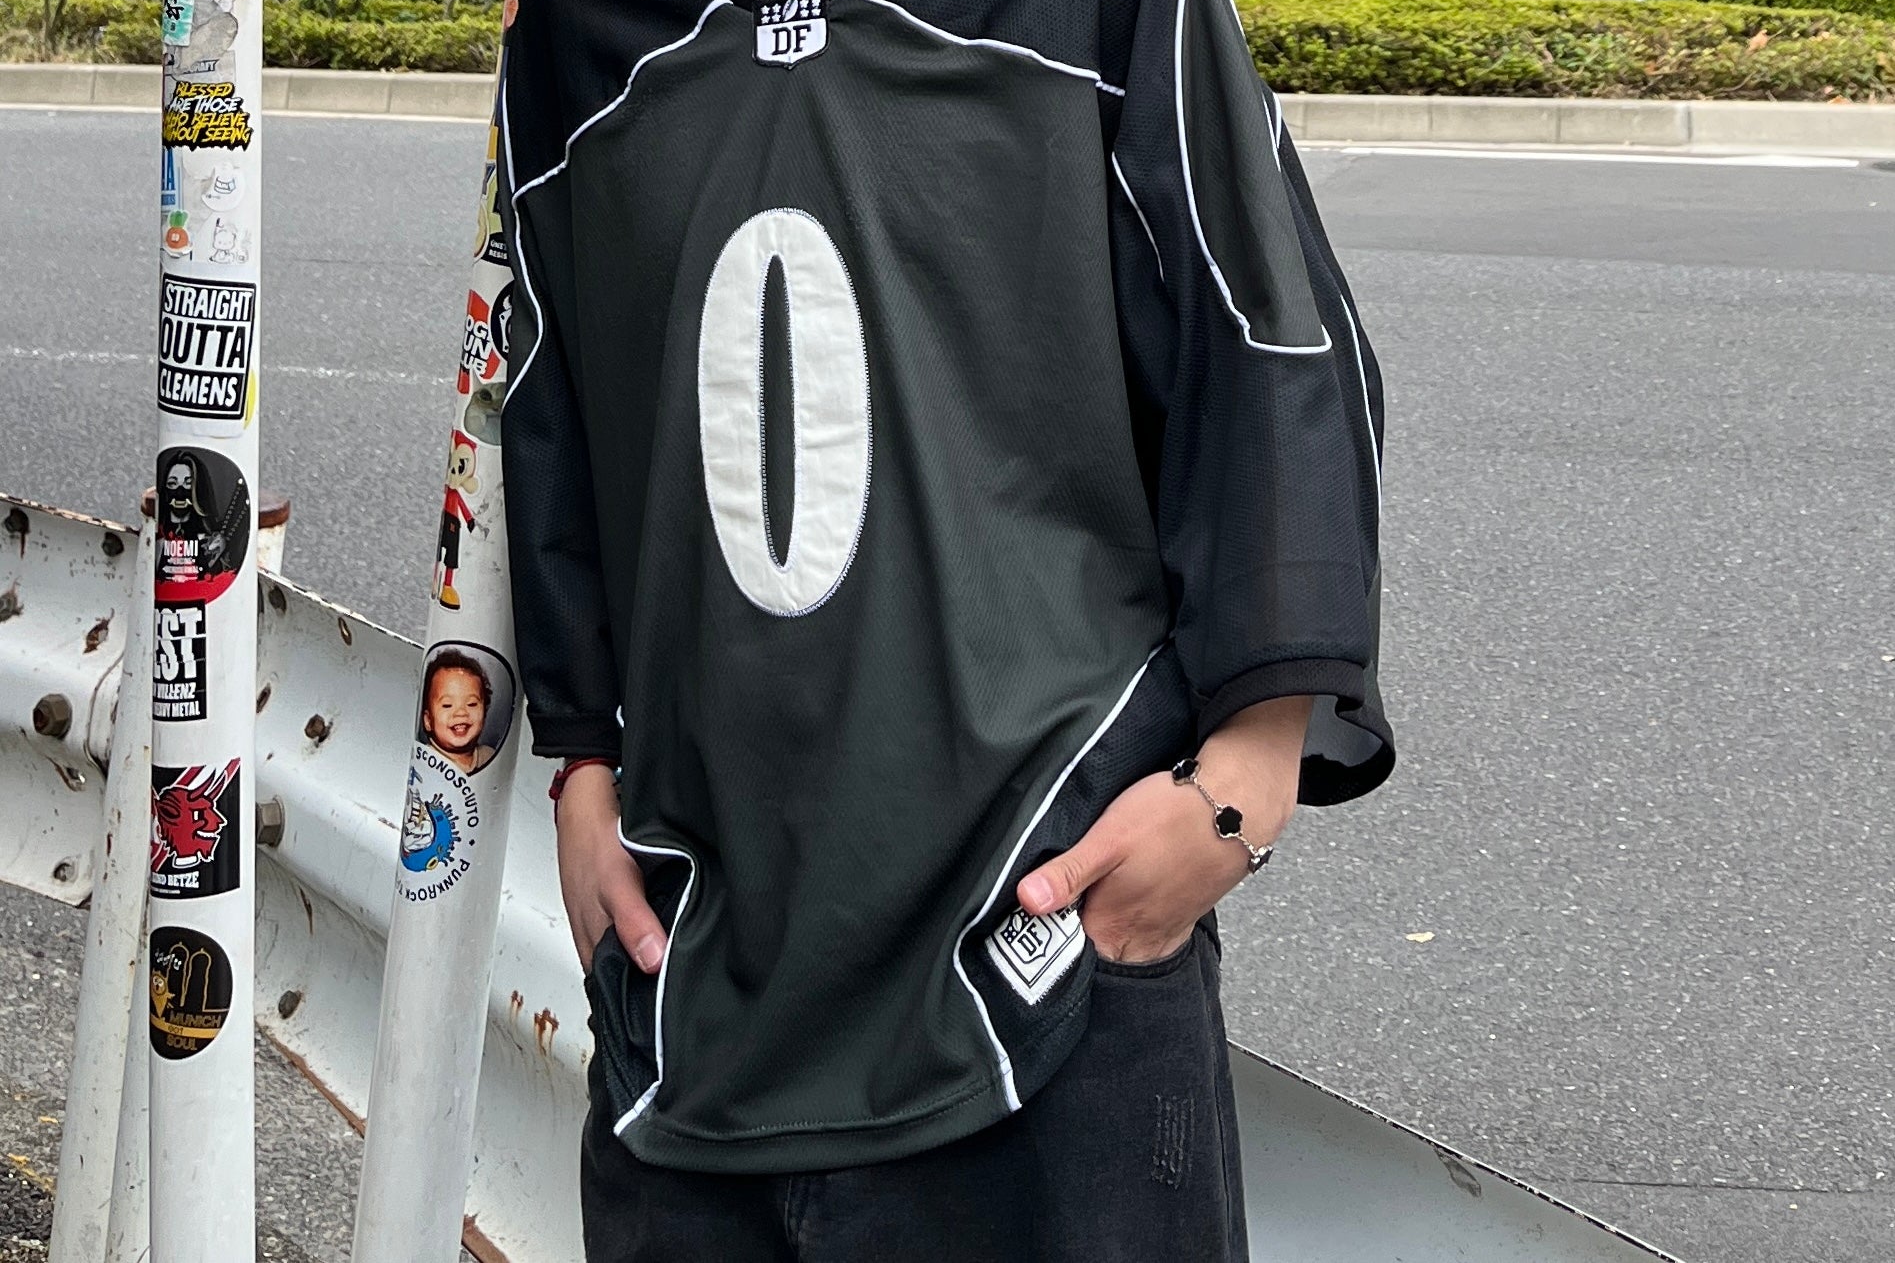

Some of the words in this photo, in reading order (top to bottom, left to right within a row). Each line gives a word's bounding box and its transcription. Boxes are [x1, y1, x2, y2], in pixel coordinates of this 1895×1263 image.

[771, 23, 812, 56] DF
[175, 81, 233, 97] BLESSED
[168, 97, 192, 114] ARE
[192, 96, 242, 114] THOSE
[190, 112, 247, 128] BELIEVE
[202, 127, 252, 144] SEEING
[164, 284, 253, 321] STRAIGHT
[160, 317, 246, 369] OUTTA
[159, 367, 238, 407] CLEMENS
[698, 207, 873, 617] 0
[164, 540, 199, 557] NOEMI
[171, 701, 201, 718] METAL
[415, 746, 480, 828] SCONOSCIUTO
[1017, 922, 1043, 956] DF
[169, 1010, 222, 1028] MUNICH
[166, 1035, 198, 1051] SOUL
